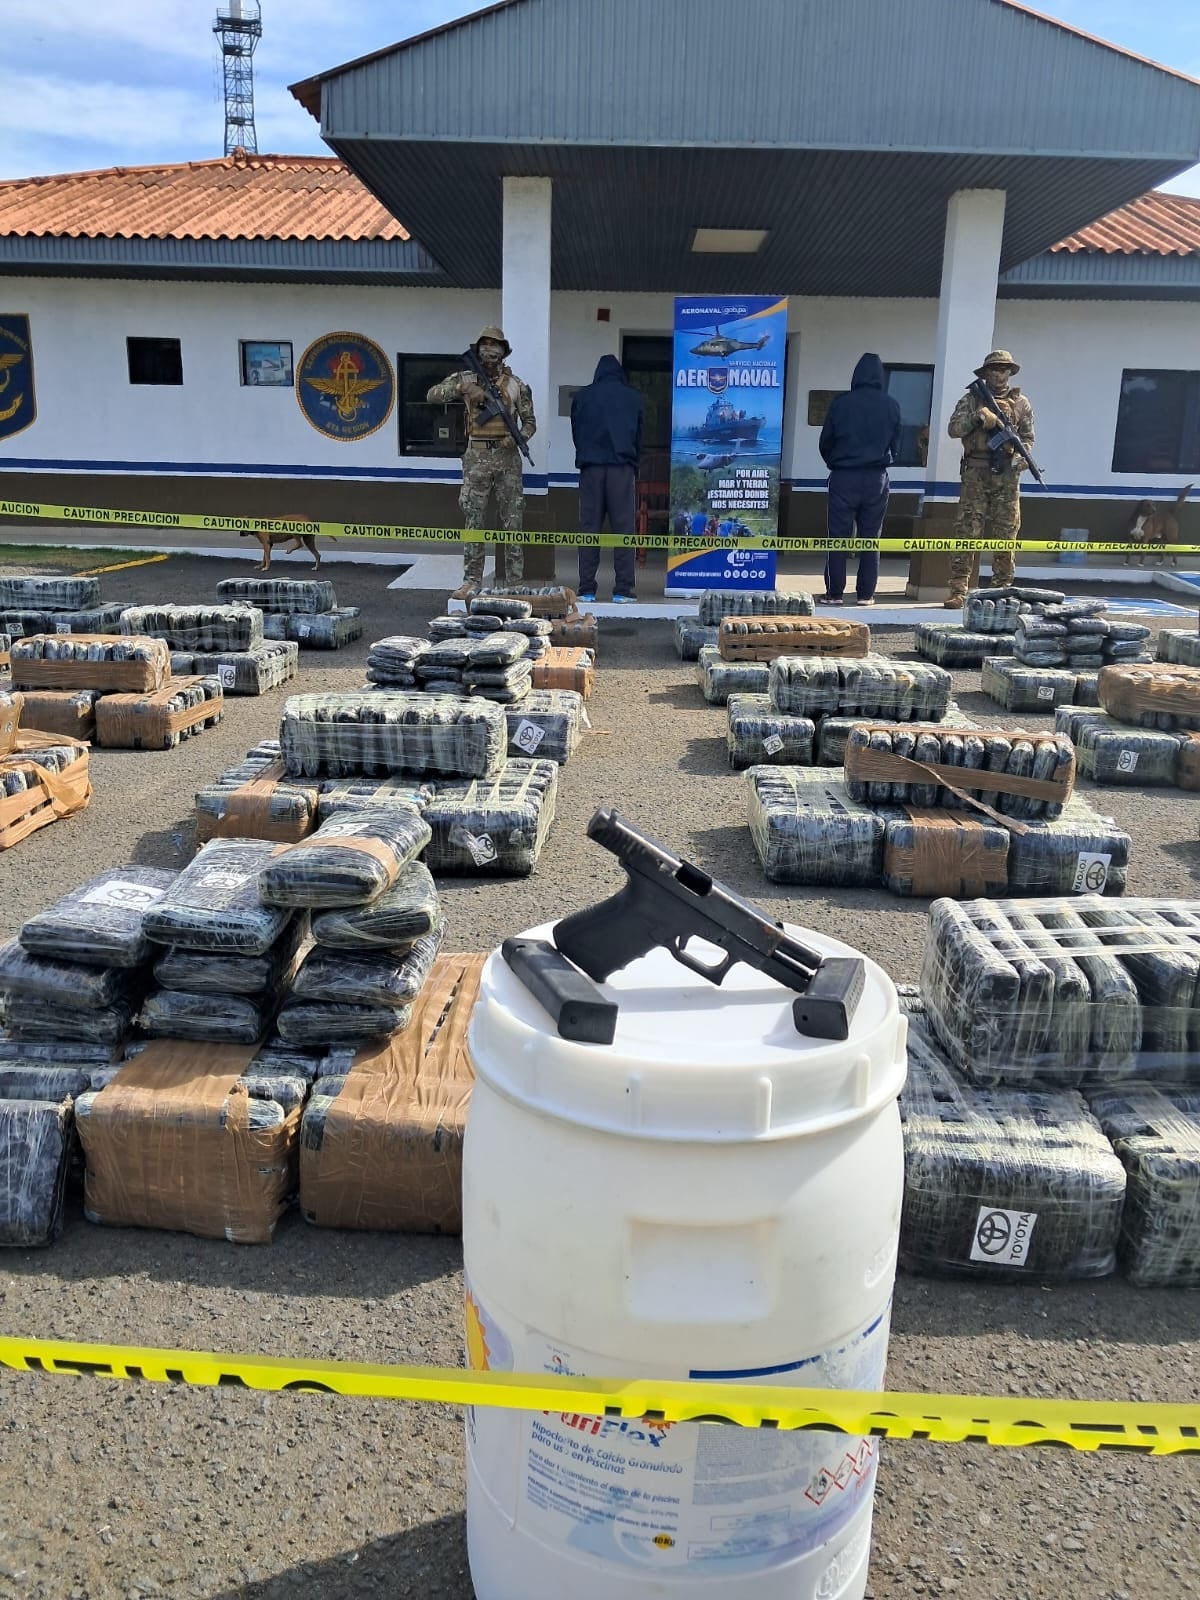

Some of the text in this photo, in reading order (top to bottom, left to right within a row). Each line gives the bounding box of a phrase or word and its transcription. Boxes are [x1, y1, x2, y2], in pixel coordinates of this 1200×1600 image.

[736, 469, 750, 478] POR
[718, 479, 735, 489] MAR
[736, 479, 742, 489] Y
[744, 489, 769, 499] DONDE
[711, 500, 727, 509] NOS
[63, 507, 180, 526] CAUTION PRECAUCION
[203, 516, 321, 534] CAUTION PRECAUCION
[344, 524, 461, 541] CAUTION PRECAUCION
[484, 531, 600, 546] CAUTION PRECAUCION
[623, 536, 739, 549] CAUTION PRECAUCION
[762, 539, 880, 550] CAUTION PRECAUCION
[903, 540, 1023, 551] CAUTION PRECAUCION
[1046, 541, 1094, 550] CAUTION
[1074, 860, 1087, 890] TOYOTA
[1010, 1213, 1031, 1260] TOYOTA
[543, 1410, 667, 1447] uriFlex
[571, 1451, 584, 1462] en
[586, 1455, 625, 1475] Piscinas
